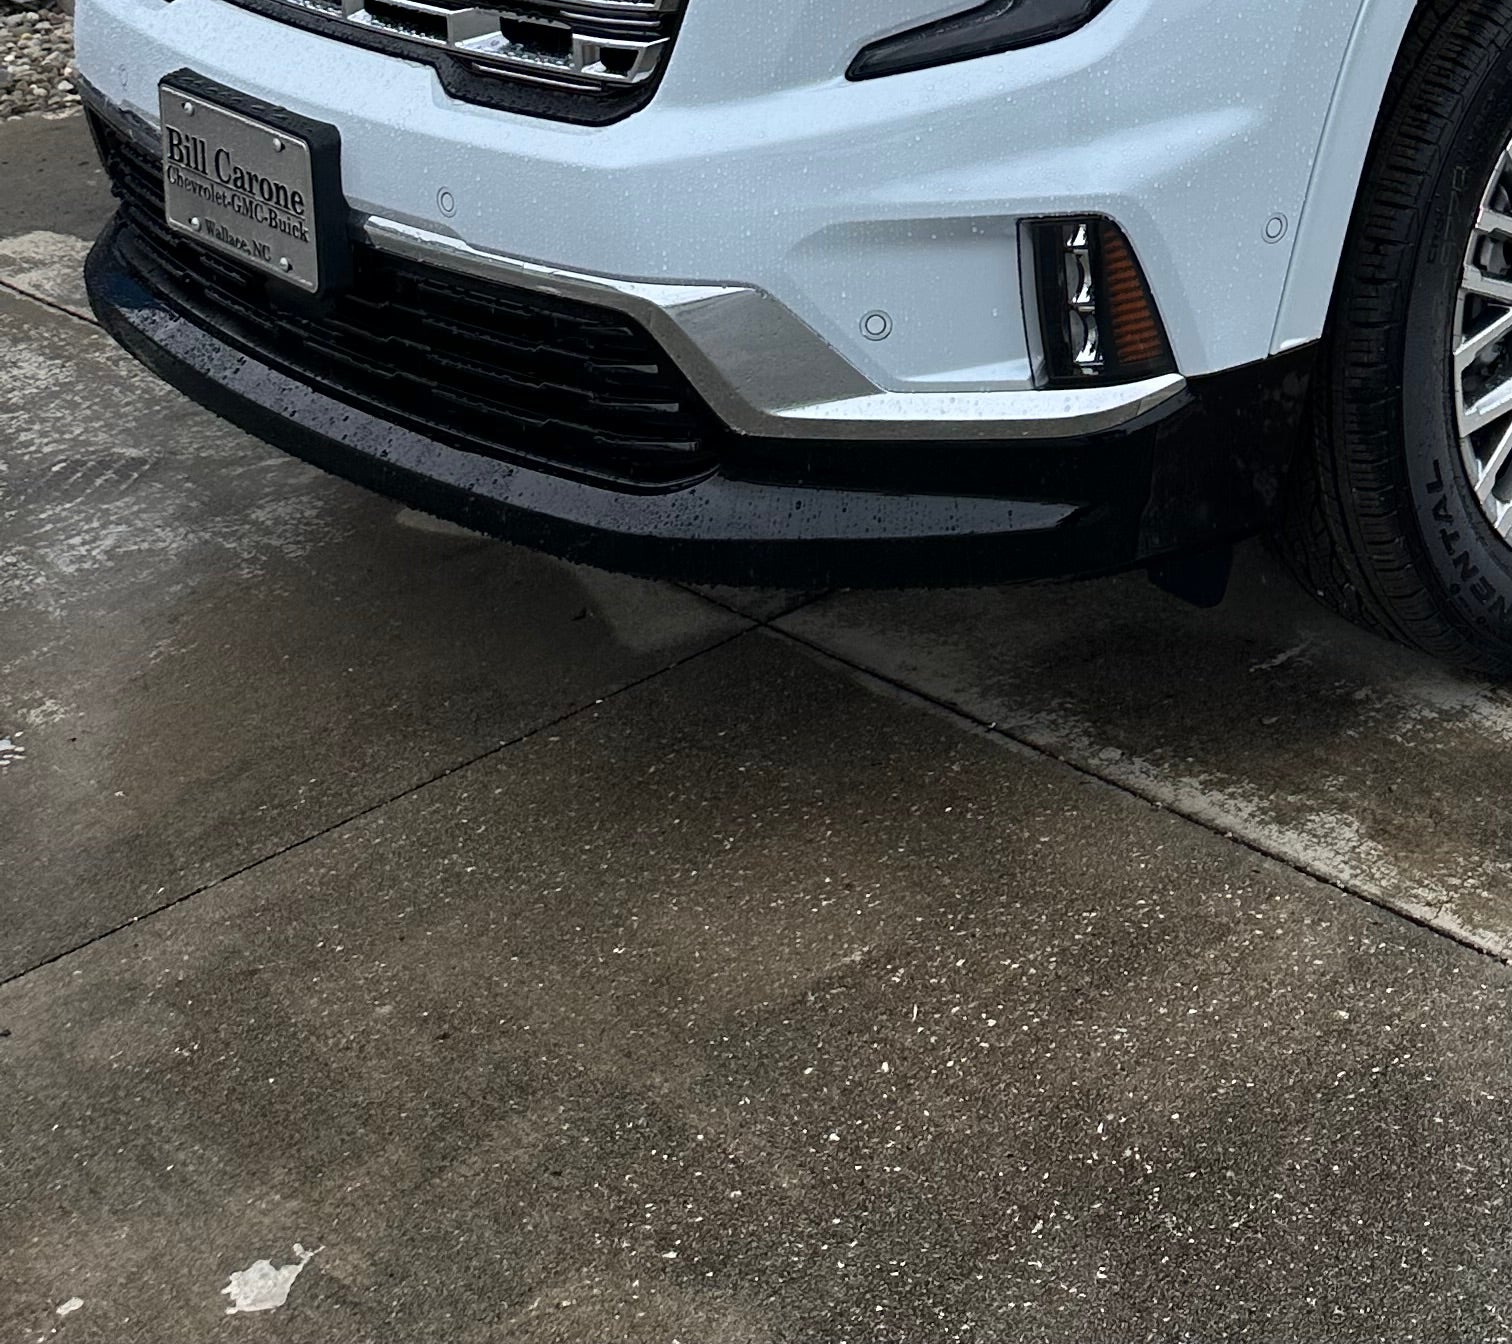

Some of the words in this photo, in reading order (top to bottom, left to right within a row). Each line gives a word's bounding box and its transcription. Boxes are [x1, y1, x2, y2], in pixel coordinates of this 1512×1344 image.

[166, 126, 208, 175] Bill
[215, 148, 305, 216] Carone
[167, 164, 309, 243] Chevrolet-GMC-Buick
[205, 218, 251, 256] Wallace,
[253, 239, 272, 262] NC
